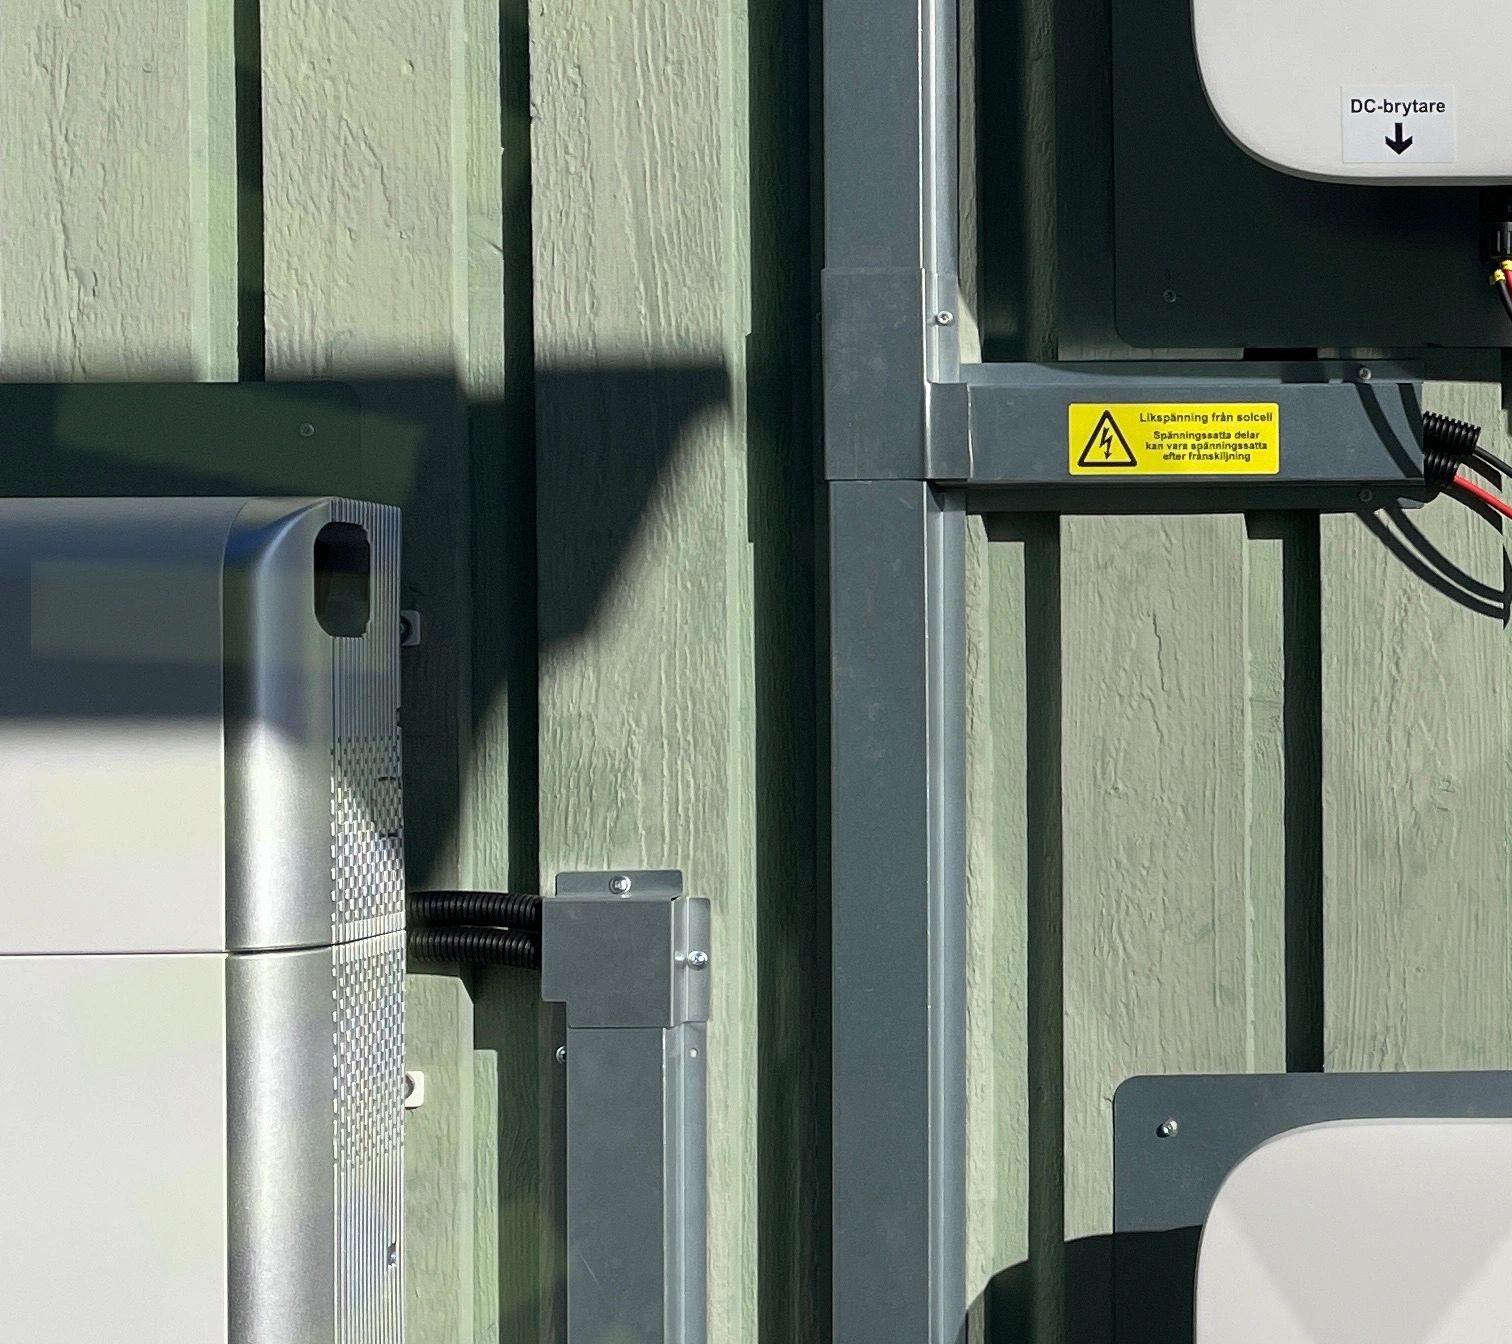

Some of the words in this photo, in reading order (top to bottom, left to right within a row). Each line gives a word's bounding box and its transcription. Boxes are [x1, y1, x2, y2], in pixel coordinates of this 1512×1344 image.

[1351, 99, 1445, 116] DC-brytare
[1140, 412, 1208, 424] Likspänning
[1212, 412, 1233, 422] från
[1237, 413, 1273, 422] solcell
[1153, 431, 1232, 441] Spänningssatta
[1234, 431, 1259, 439] delar
[1145, 442, 1163, 450] kan
[1191, 442, 1267, 452] spänningssatta
[1163, 452, 1186, 460] efter
